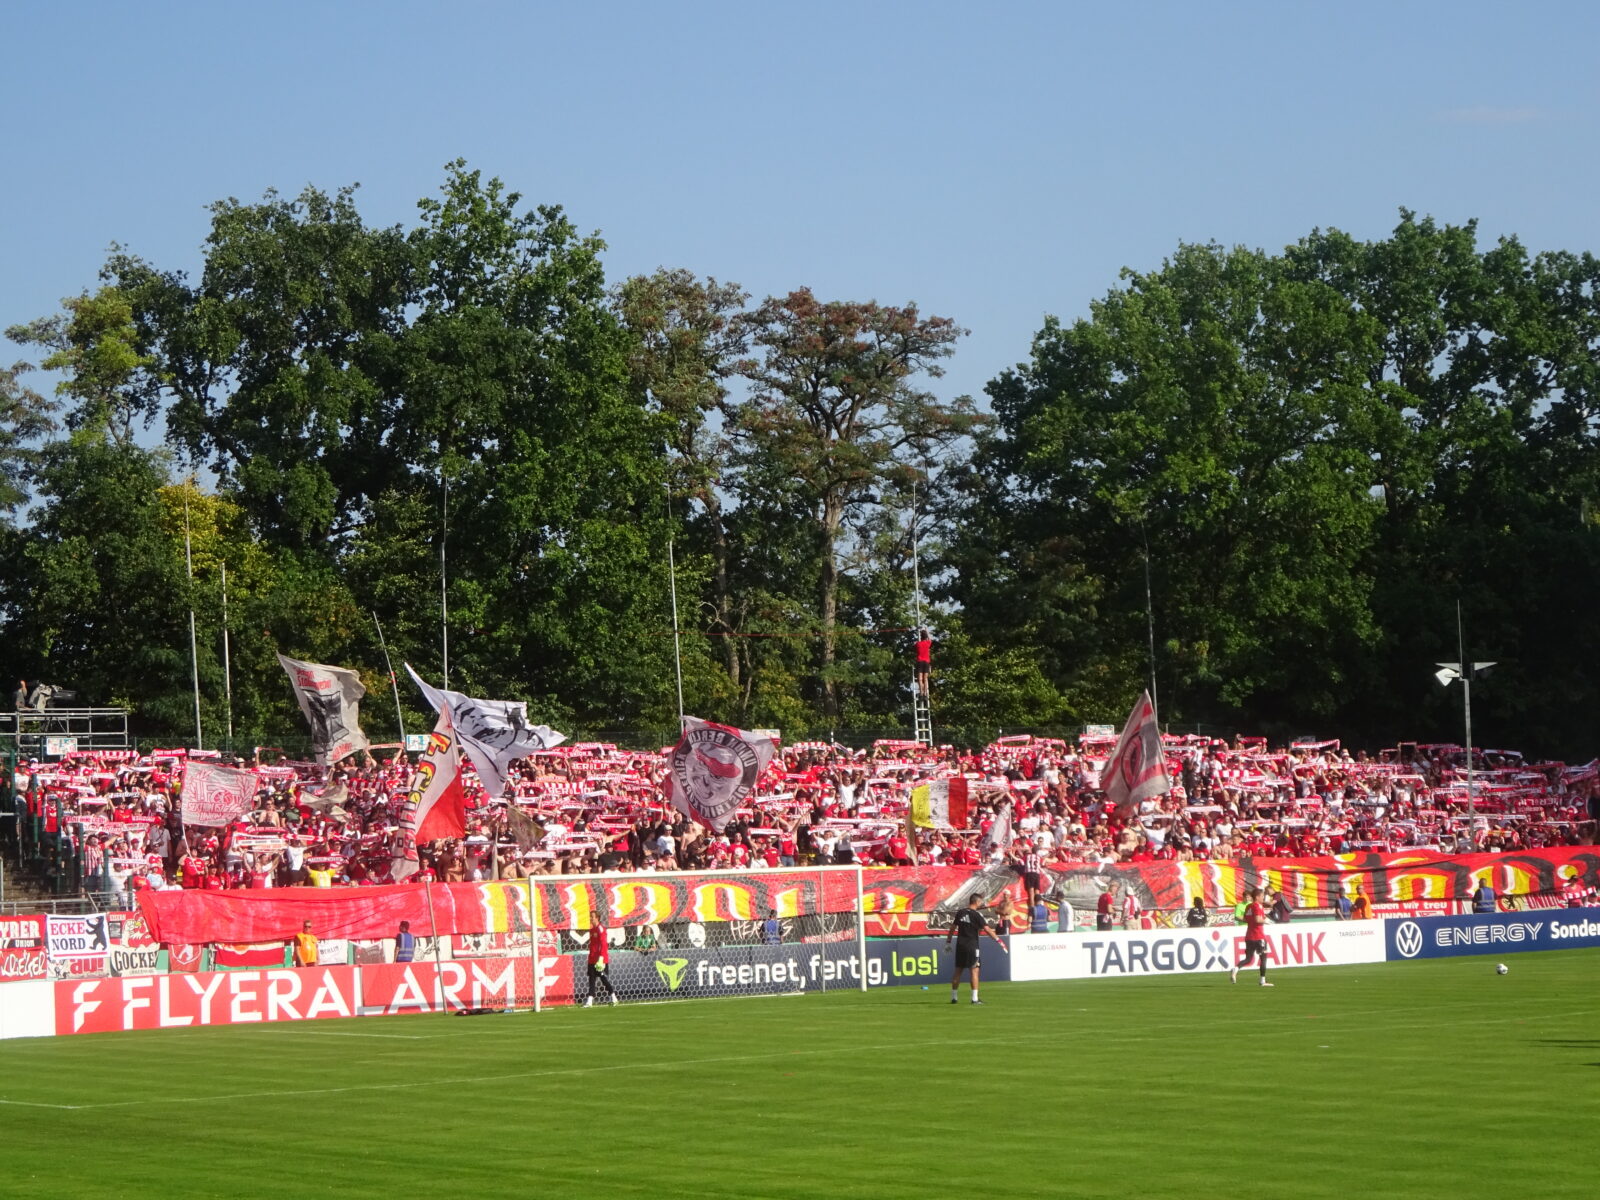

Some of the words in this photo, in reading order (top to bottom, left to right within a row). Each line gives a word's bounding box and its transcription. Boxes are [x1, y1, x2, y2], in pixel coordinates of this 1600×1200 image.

[51, 922, 85, 935] ECKE
[1436, 922, 1544, 947] ENERGY
[52, 937, 86, 951] NORD
[697, 958, 806, 989] freenet,
[809, 954, 888, 985] fertg,
[892, 950, 938, 977] los!
